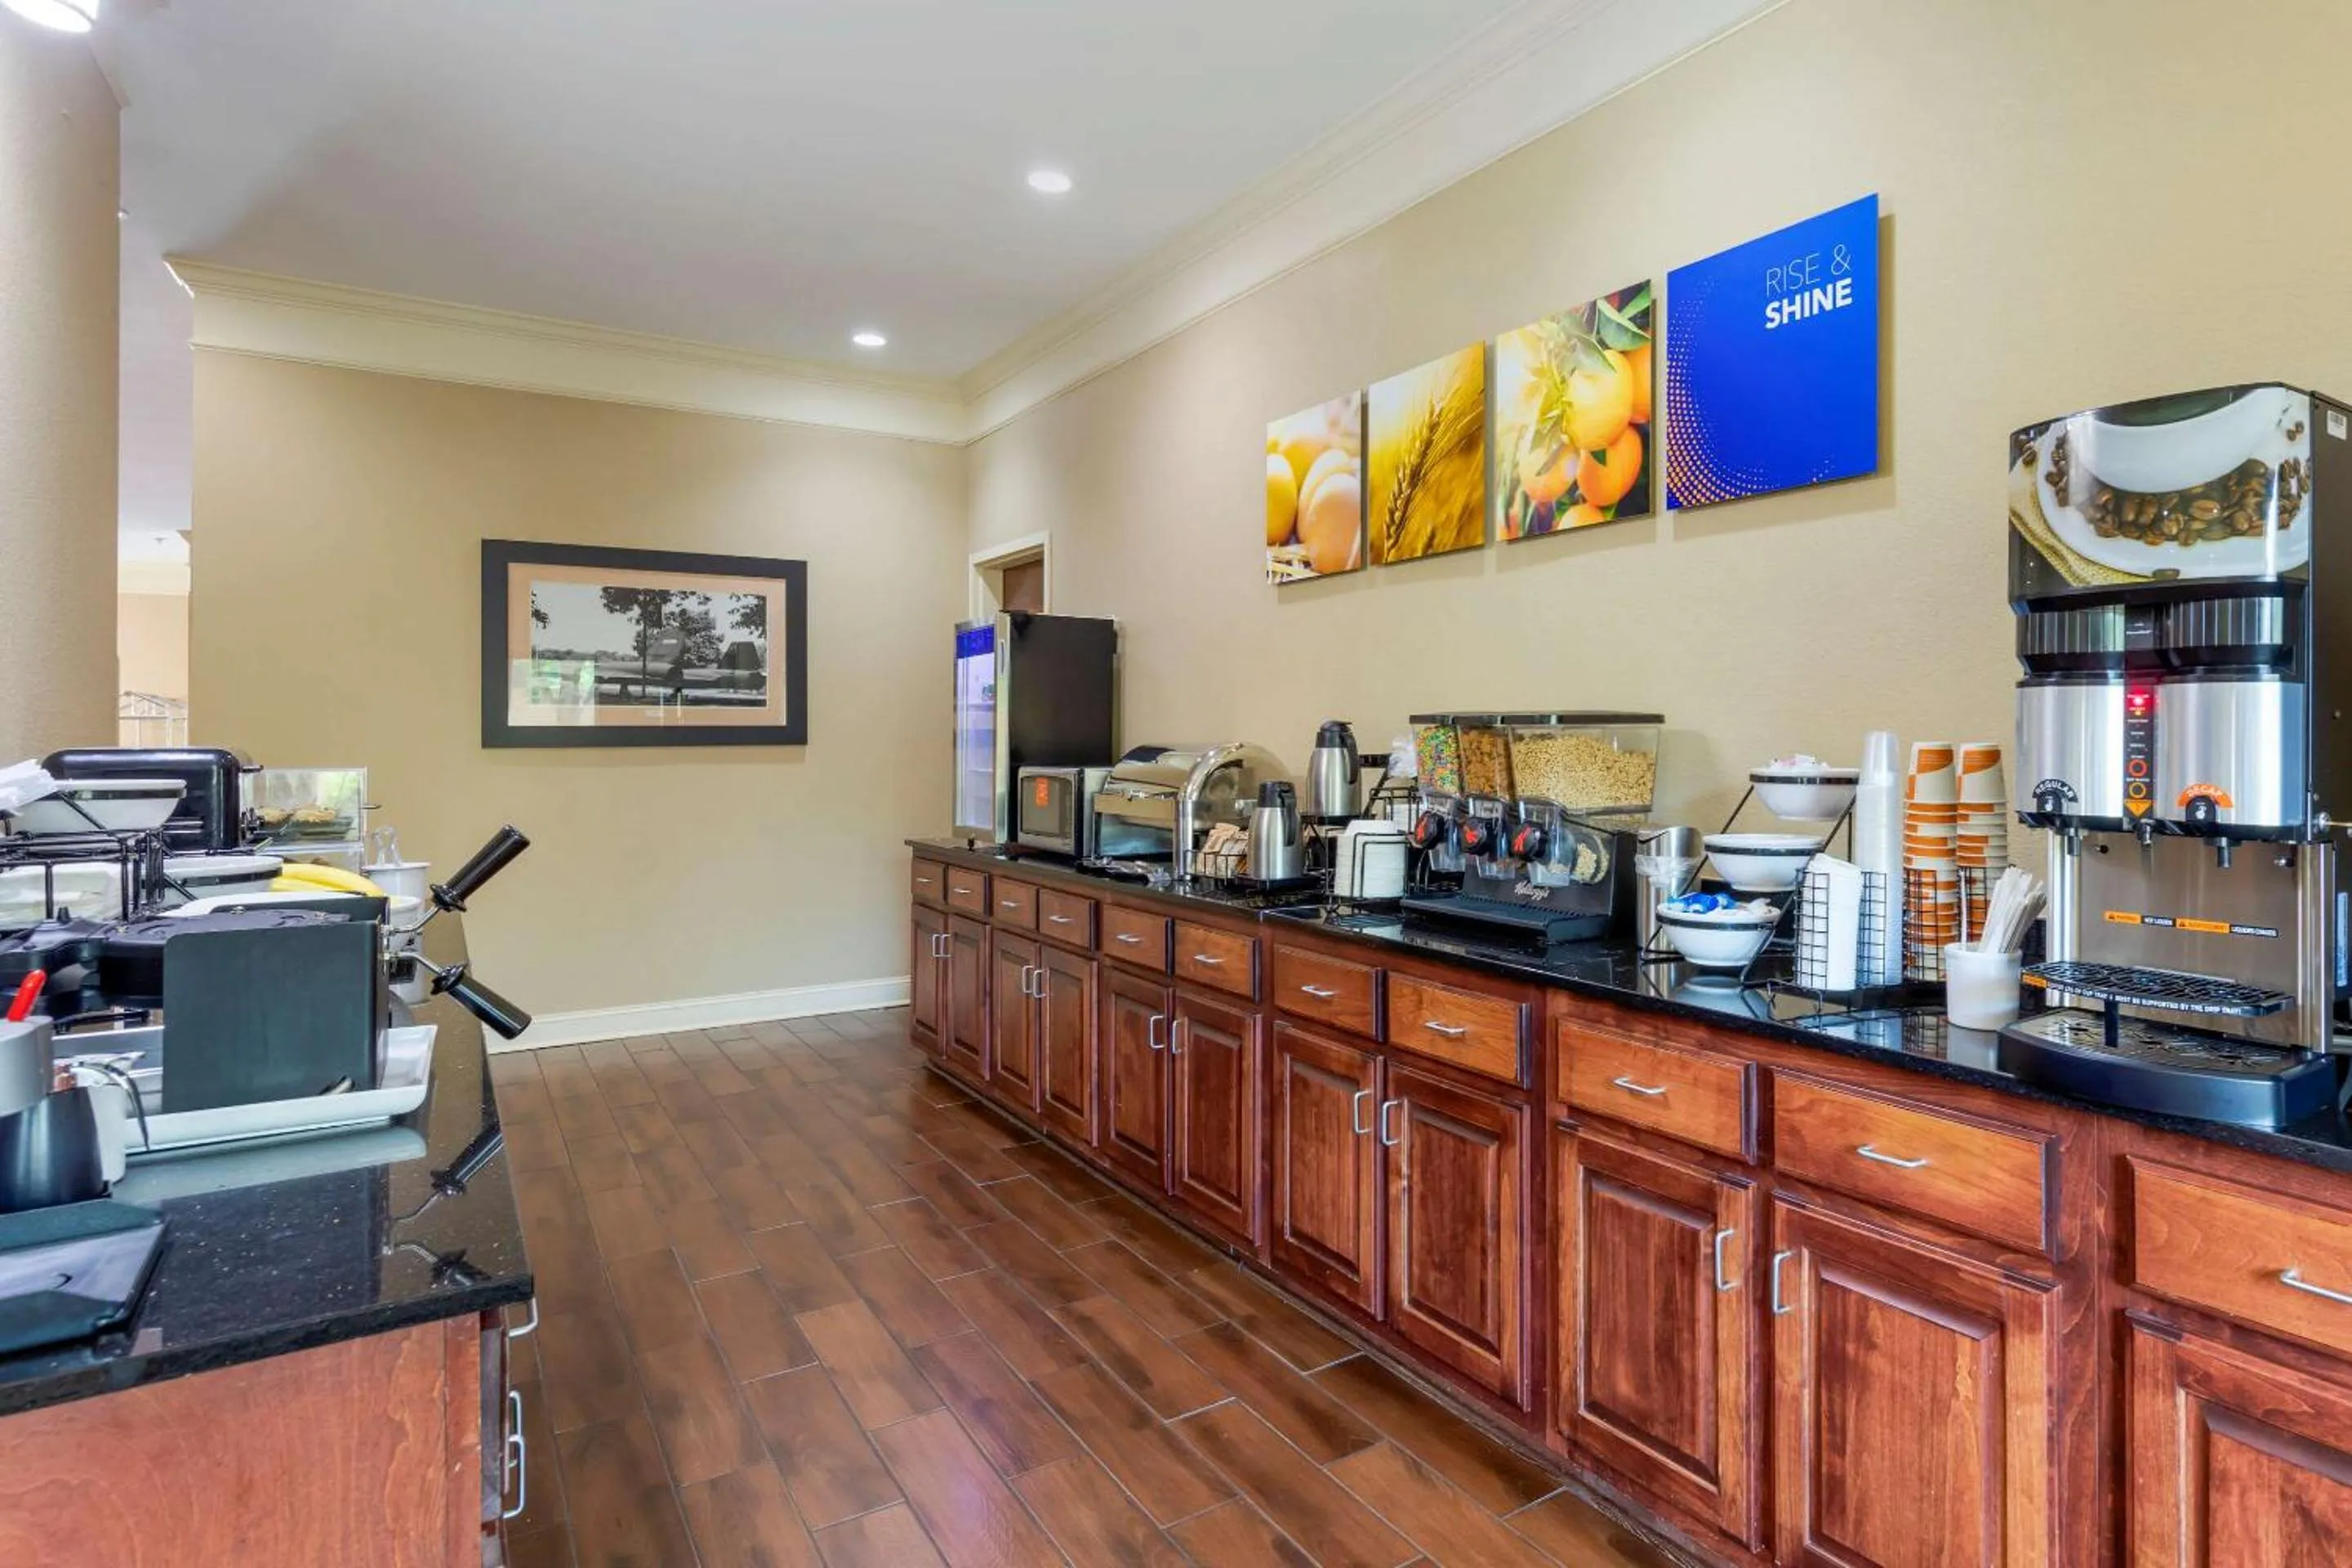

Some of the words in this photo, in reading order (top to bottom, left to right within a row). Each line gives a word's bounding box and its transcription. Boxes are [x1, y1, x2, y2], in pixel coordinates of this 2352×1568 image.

[1766, 252, 1821, 298] RISE
[1830, 243, 1851, 276] &
[1765, 276, 1853, 329] SHINE
[2034, 779, 2075, 799] REGULAR
[1514, 880, 1550, 901] Kellogg's
